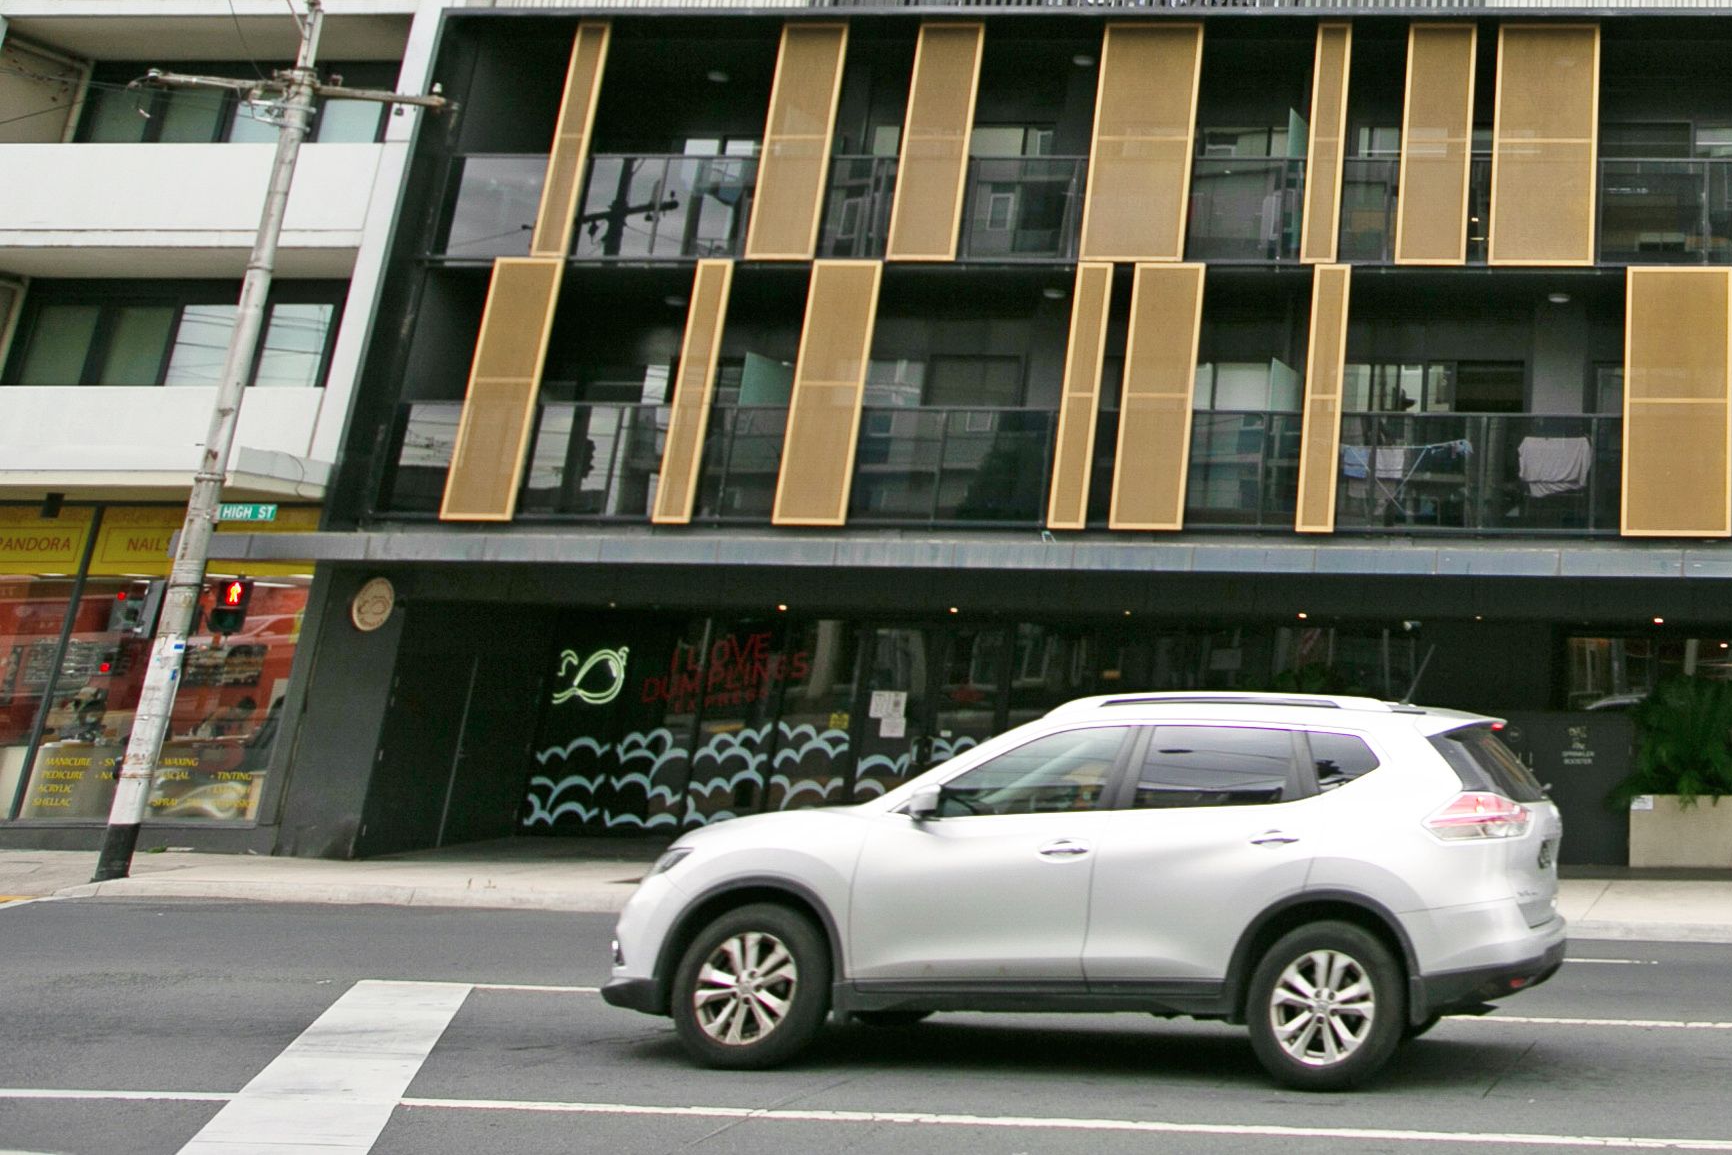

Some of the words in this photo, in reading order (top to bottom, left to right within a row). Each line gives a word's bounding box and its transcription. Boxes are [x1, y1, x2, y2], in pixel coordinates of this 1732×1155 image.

[222, 505, 252, 519] HIGH
[257, 505, 275, 519] ST
[687, 631, 772, 671] LOVE
[641, 651, 809, 704] DUMPLINGS
[46, 757, 92, 767] MANICURE
[164, 757, 199, 767] WAXING
[42, 771, 85, 780] PEDICURE
[217, 771, 253, 781] TINTING
[32, 797, 71, 807] SHELLAC
